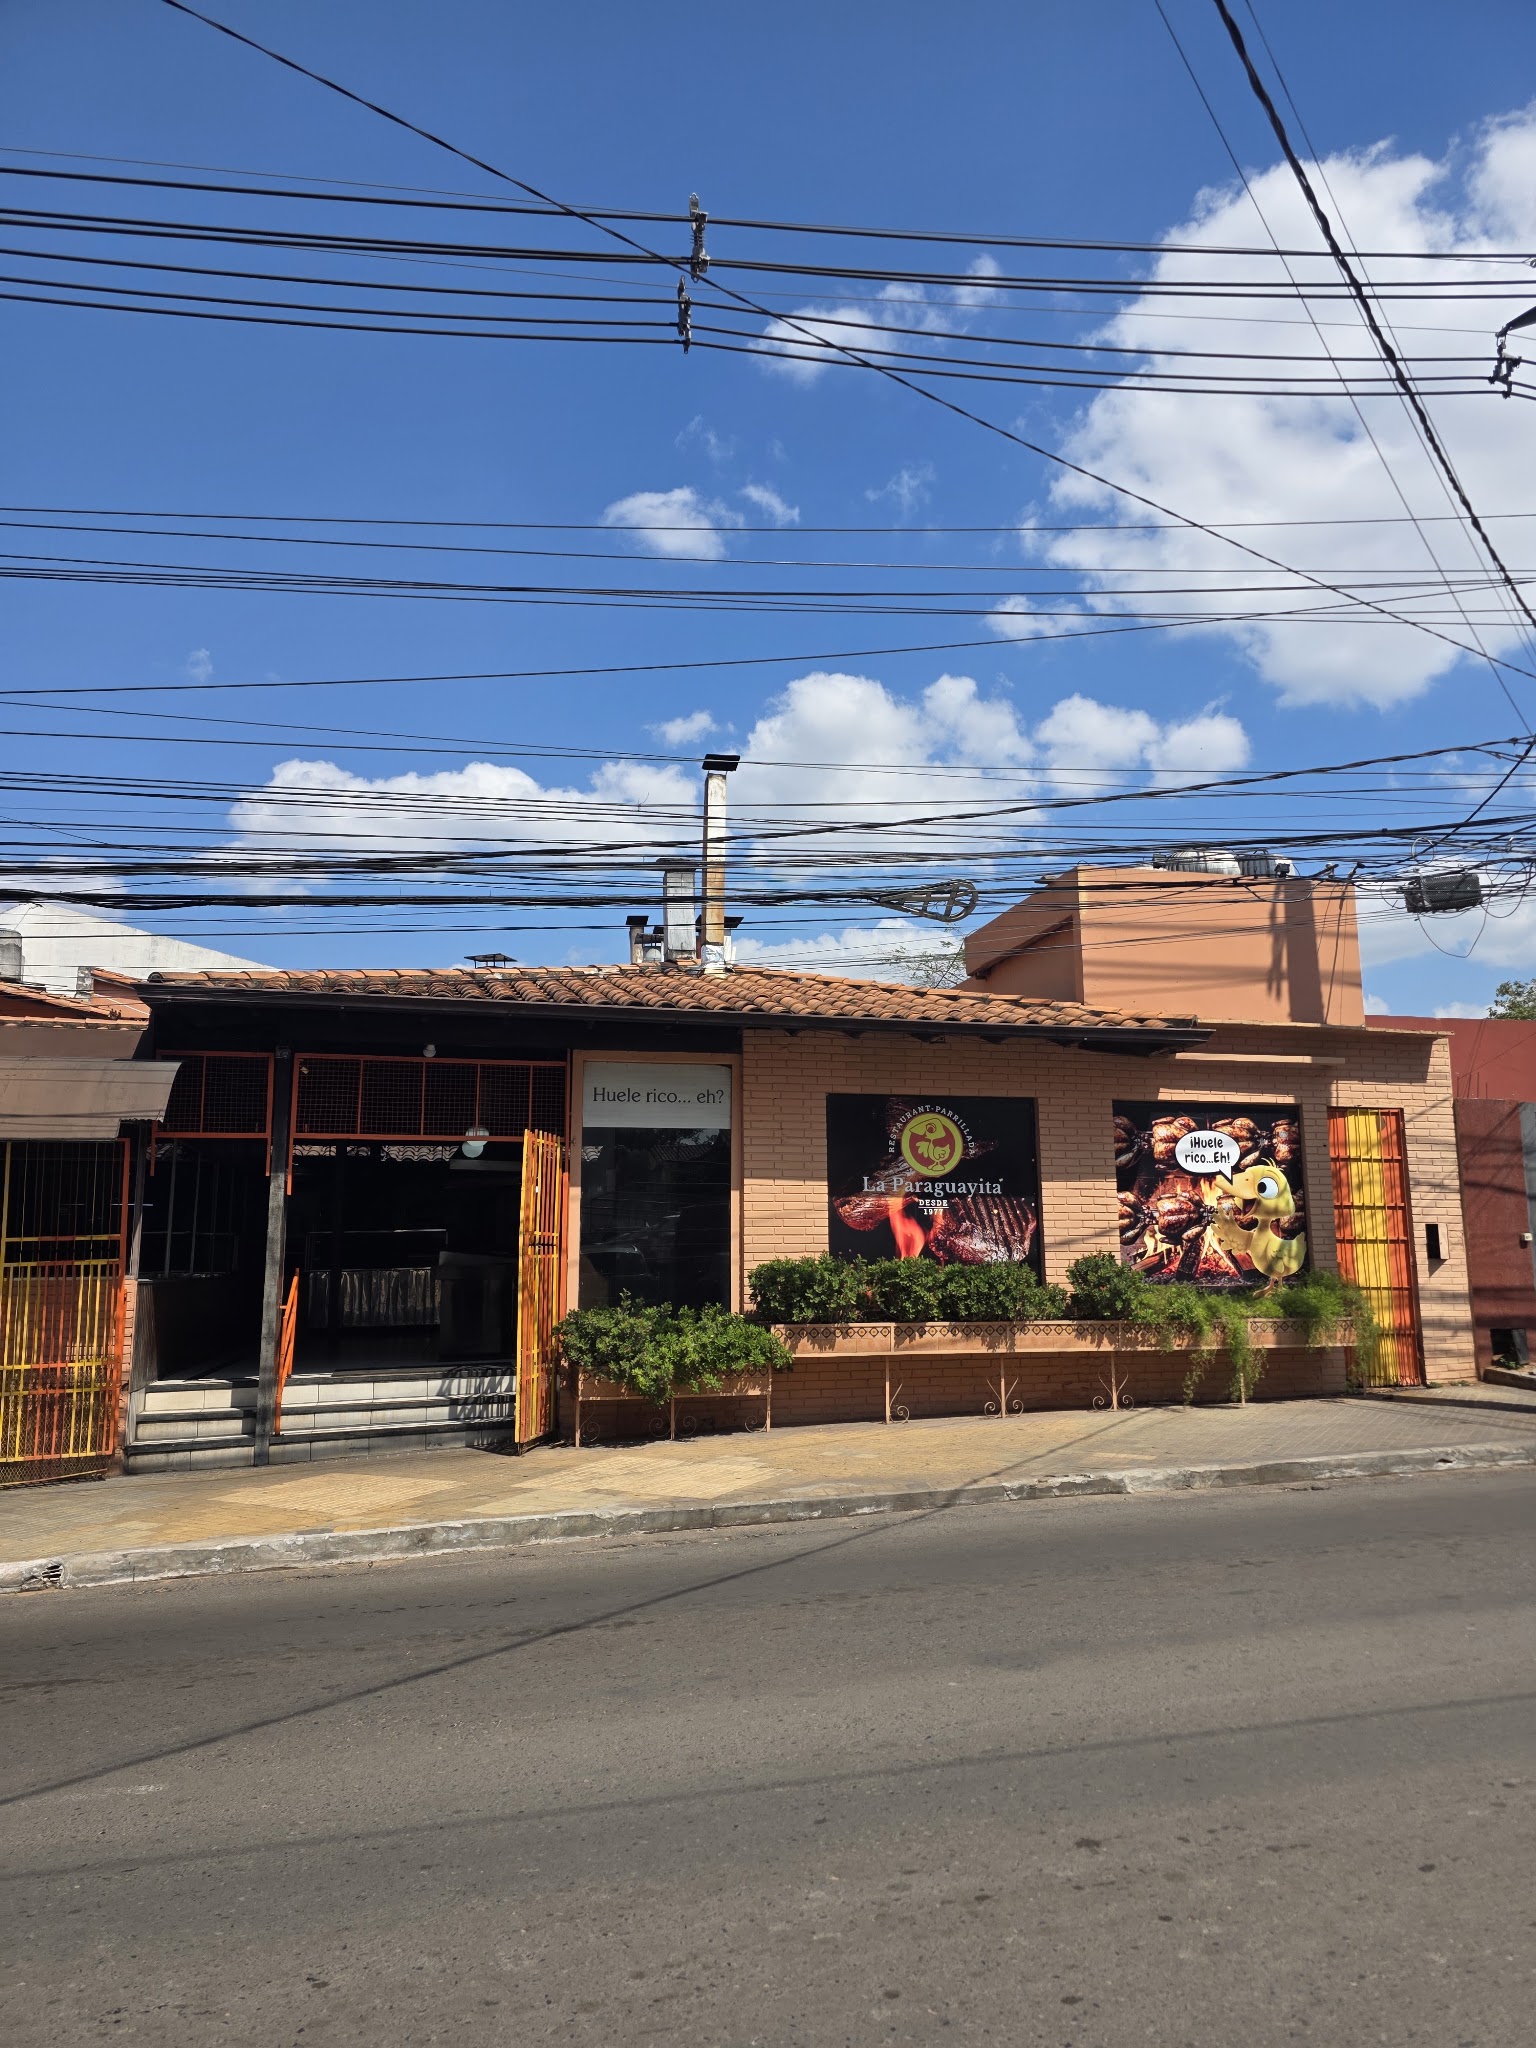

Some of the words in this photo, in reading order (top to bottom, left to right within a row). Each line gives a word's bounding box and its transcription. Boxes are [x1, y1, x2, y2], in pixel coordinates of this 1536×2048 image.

[593, 1087, 641, 1102] Huele
[645, 1088, 691, 1103] rico...
[696, 1089, 725, 1103] eh?
[1190, 1136, 1223, 1148] ¡Huele
[862, 1176, 885, 1193] La
[918, 1199, 949, 1207] DESDE
[923, 1208, 944, 1216] 1977
